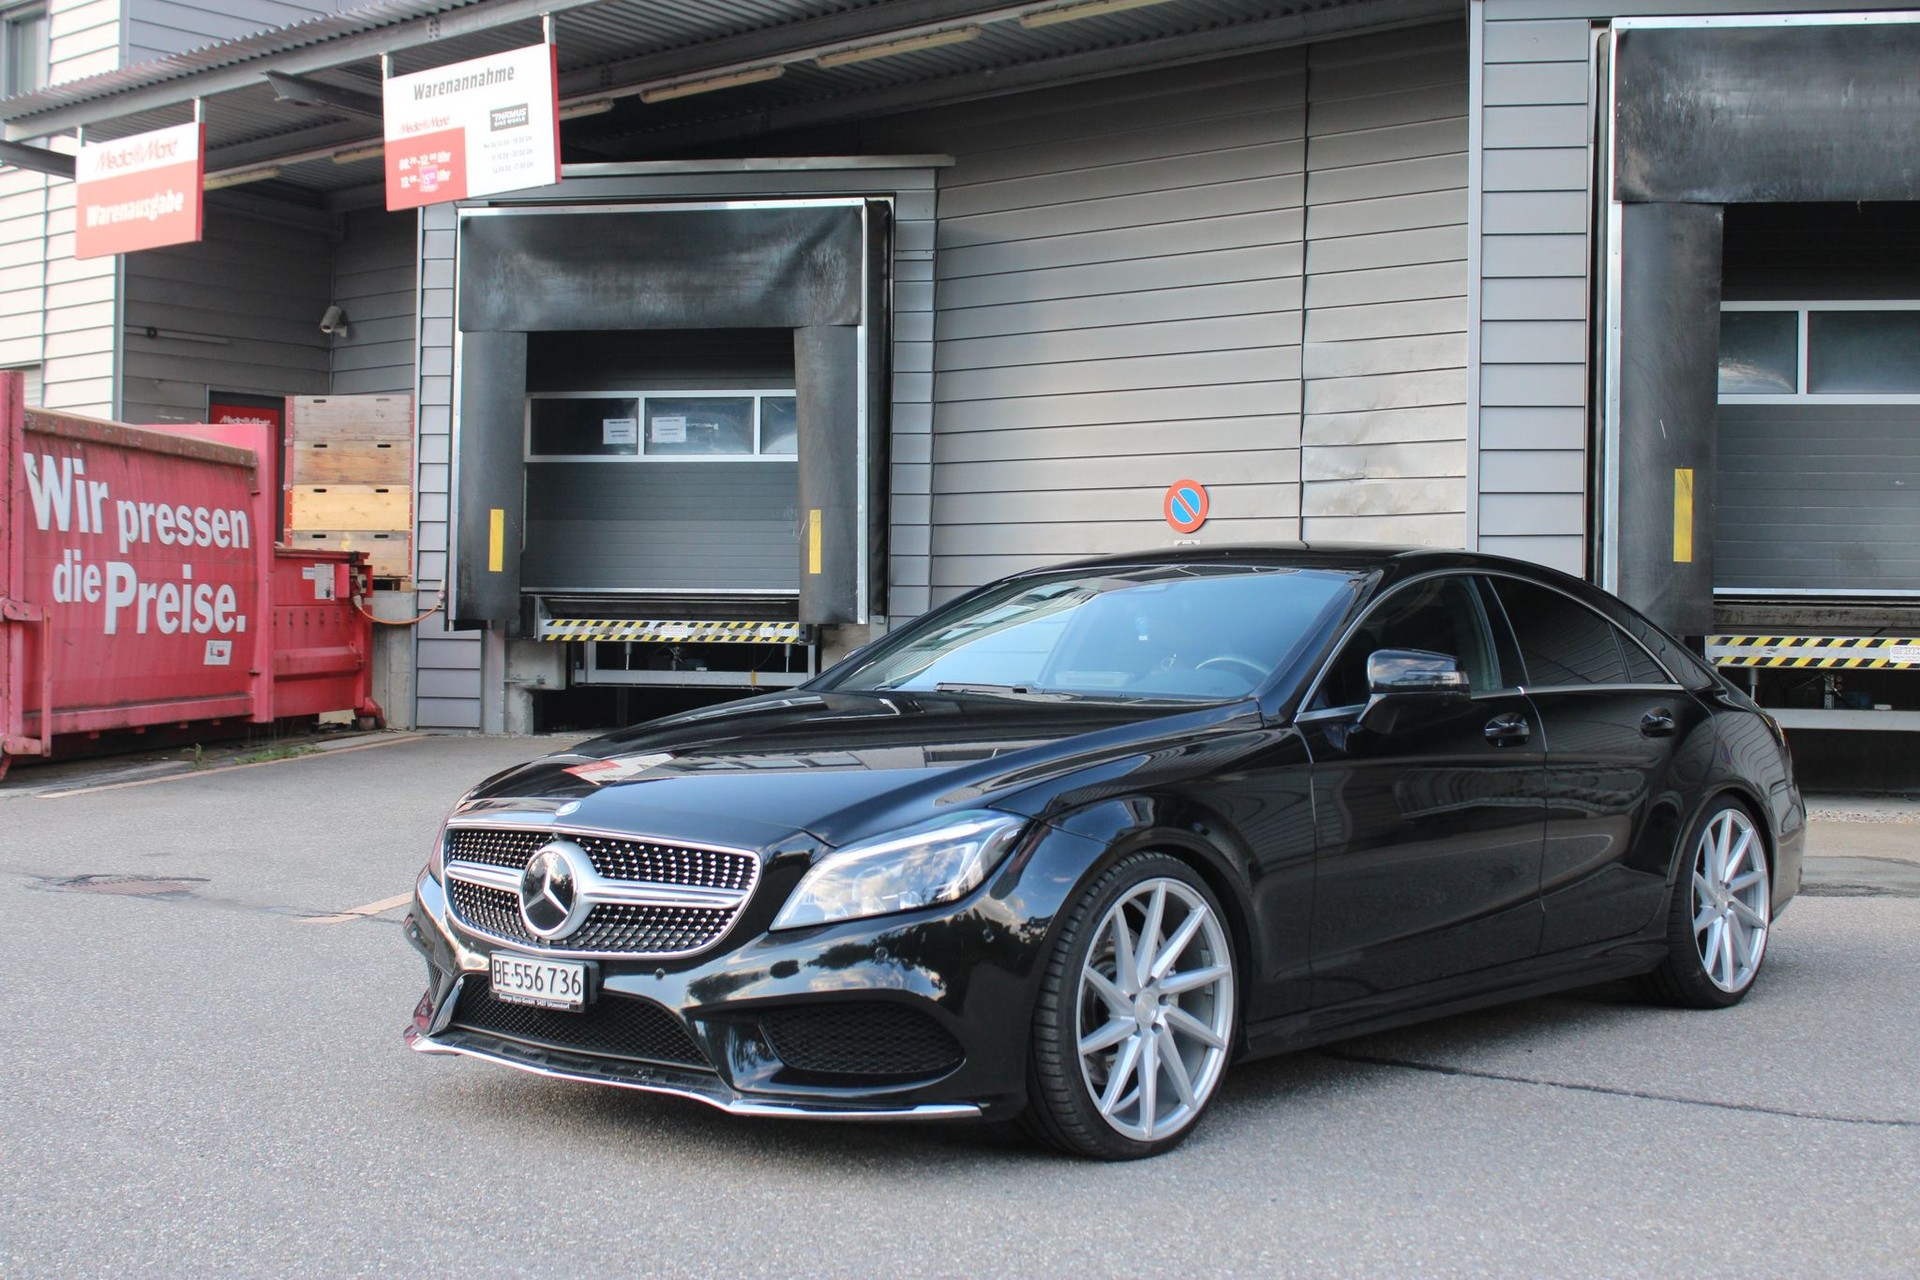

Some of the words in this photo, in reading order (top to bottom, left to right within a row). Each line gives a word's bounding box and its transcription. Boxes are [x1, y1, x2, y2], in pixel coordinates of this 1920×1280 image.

[414, 66, 515, 101] Warenannahme
[86, 189, 184, 228] Warenausgabe
[23, 452, 109, 534] Wir
[117, 500, 249, 554] pressen
[53, 549, 102, 603] die
[104, 561, 246, 635] Preise.
